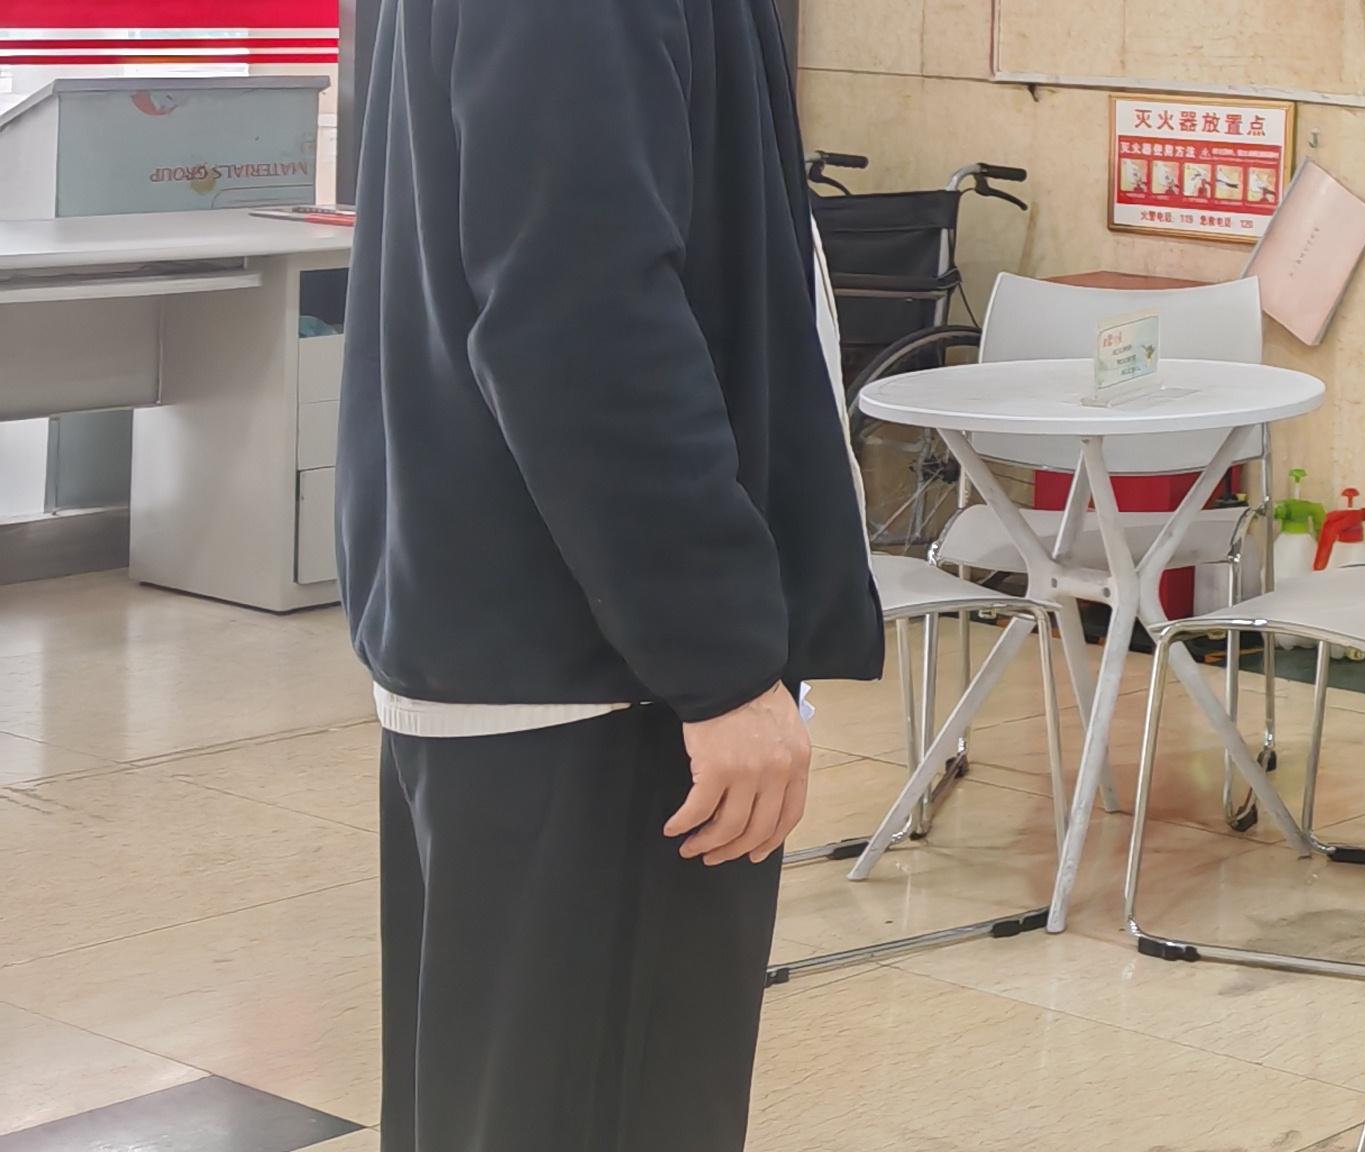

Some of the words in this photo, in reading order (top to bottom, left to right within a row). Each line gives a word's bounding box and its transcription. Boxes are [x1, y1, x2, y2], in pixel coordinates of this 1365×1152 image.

[1134, 109, 1266, 136] 灭火器放置点
